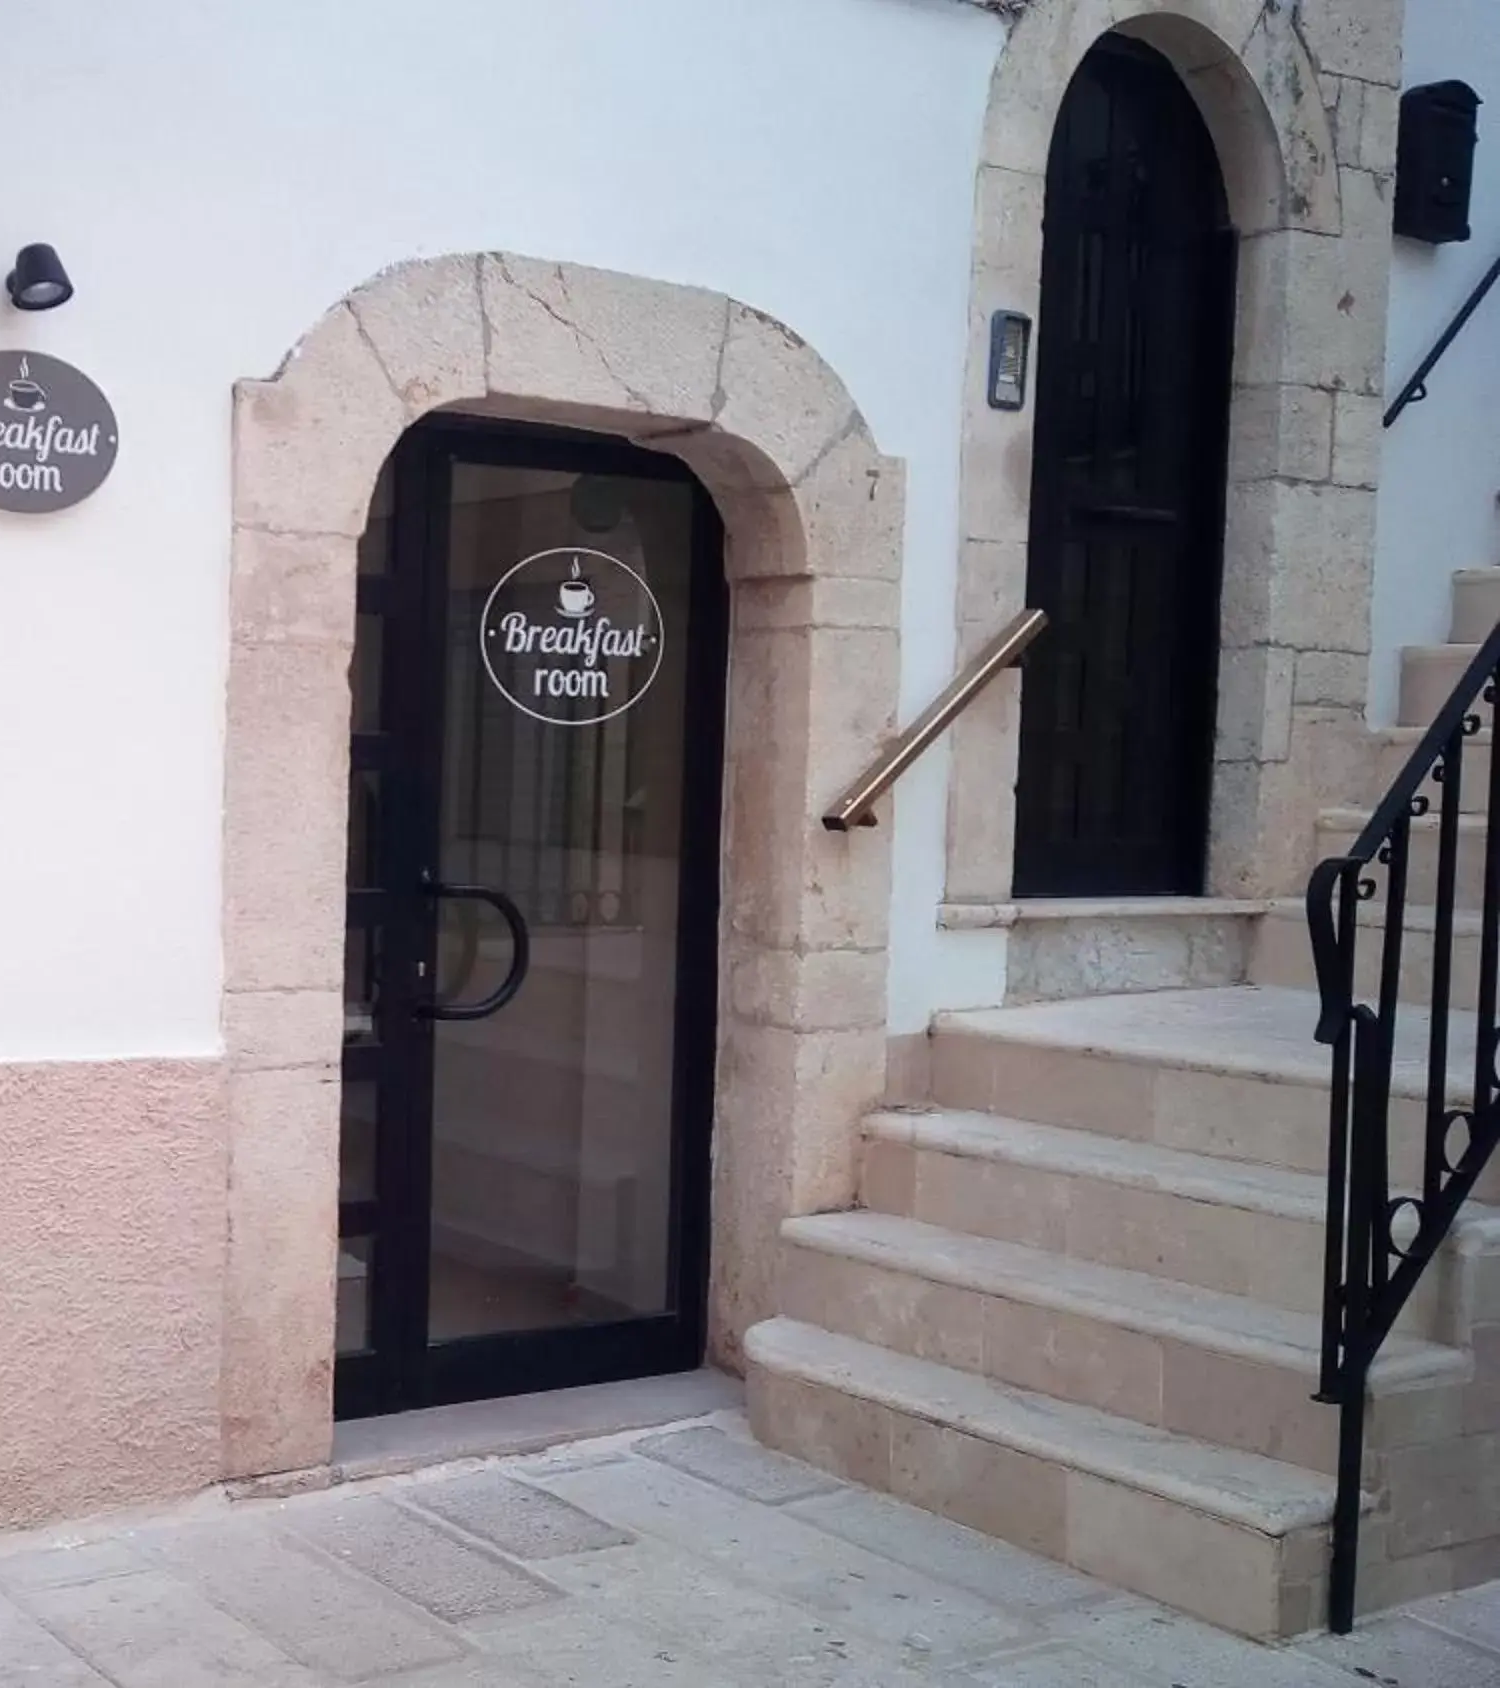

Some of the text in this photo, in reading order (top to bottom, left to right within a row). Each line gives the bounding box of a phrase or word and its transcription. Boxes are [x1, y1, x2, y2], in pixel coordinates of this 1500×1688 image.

[865, 469, 881, 502] 7
[500, 611, 645, 667] Breakfast
[534, 667, 610, 697] room
